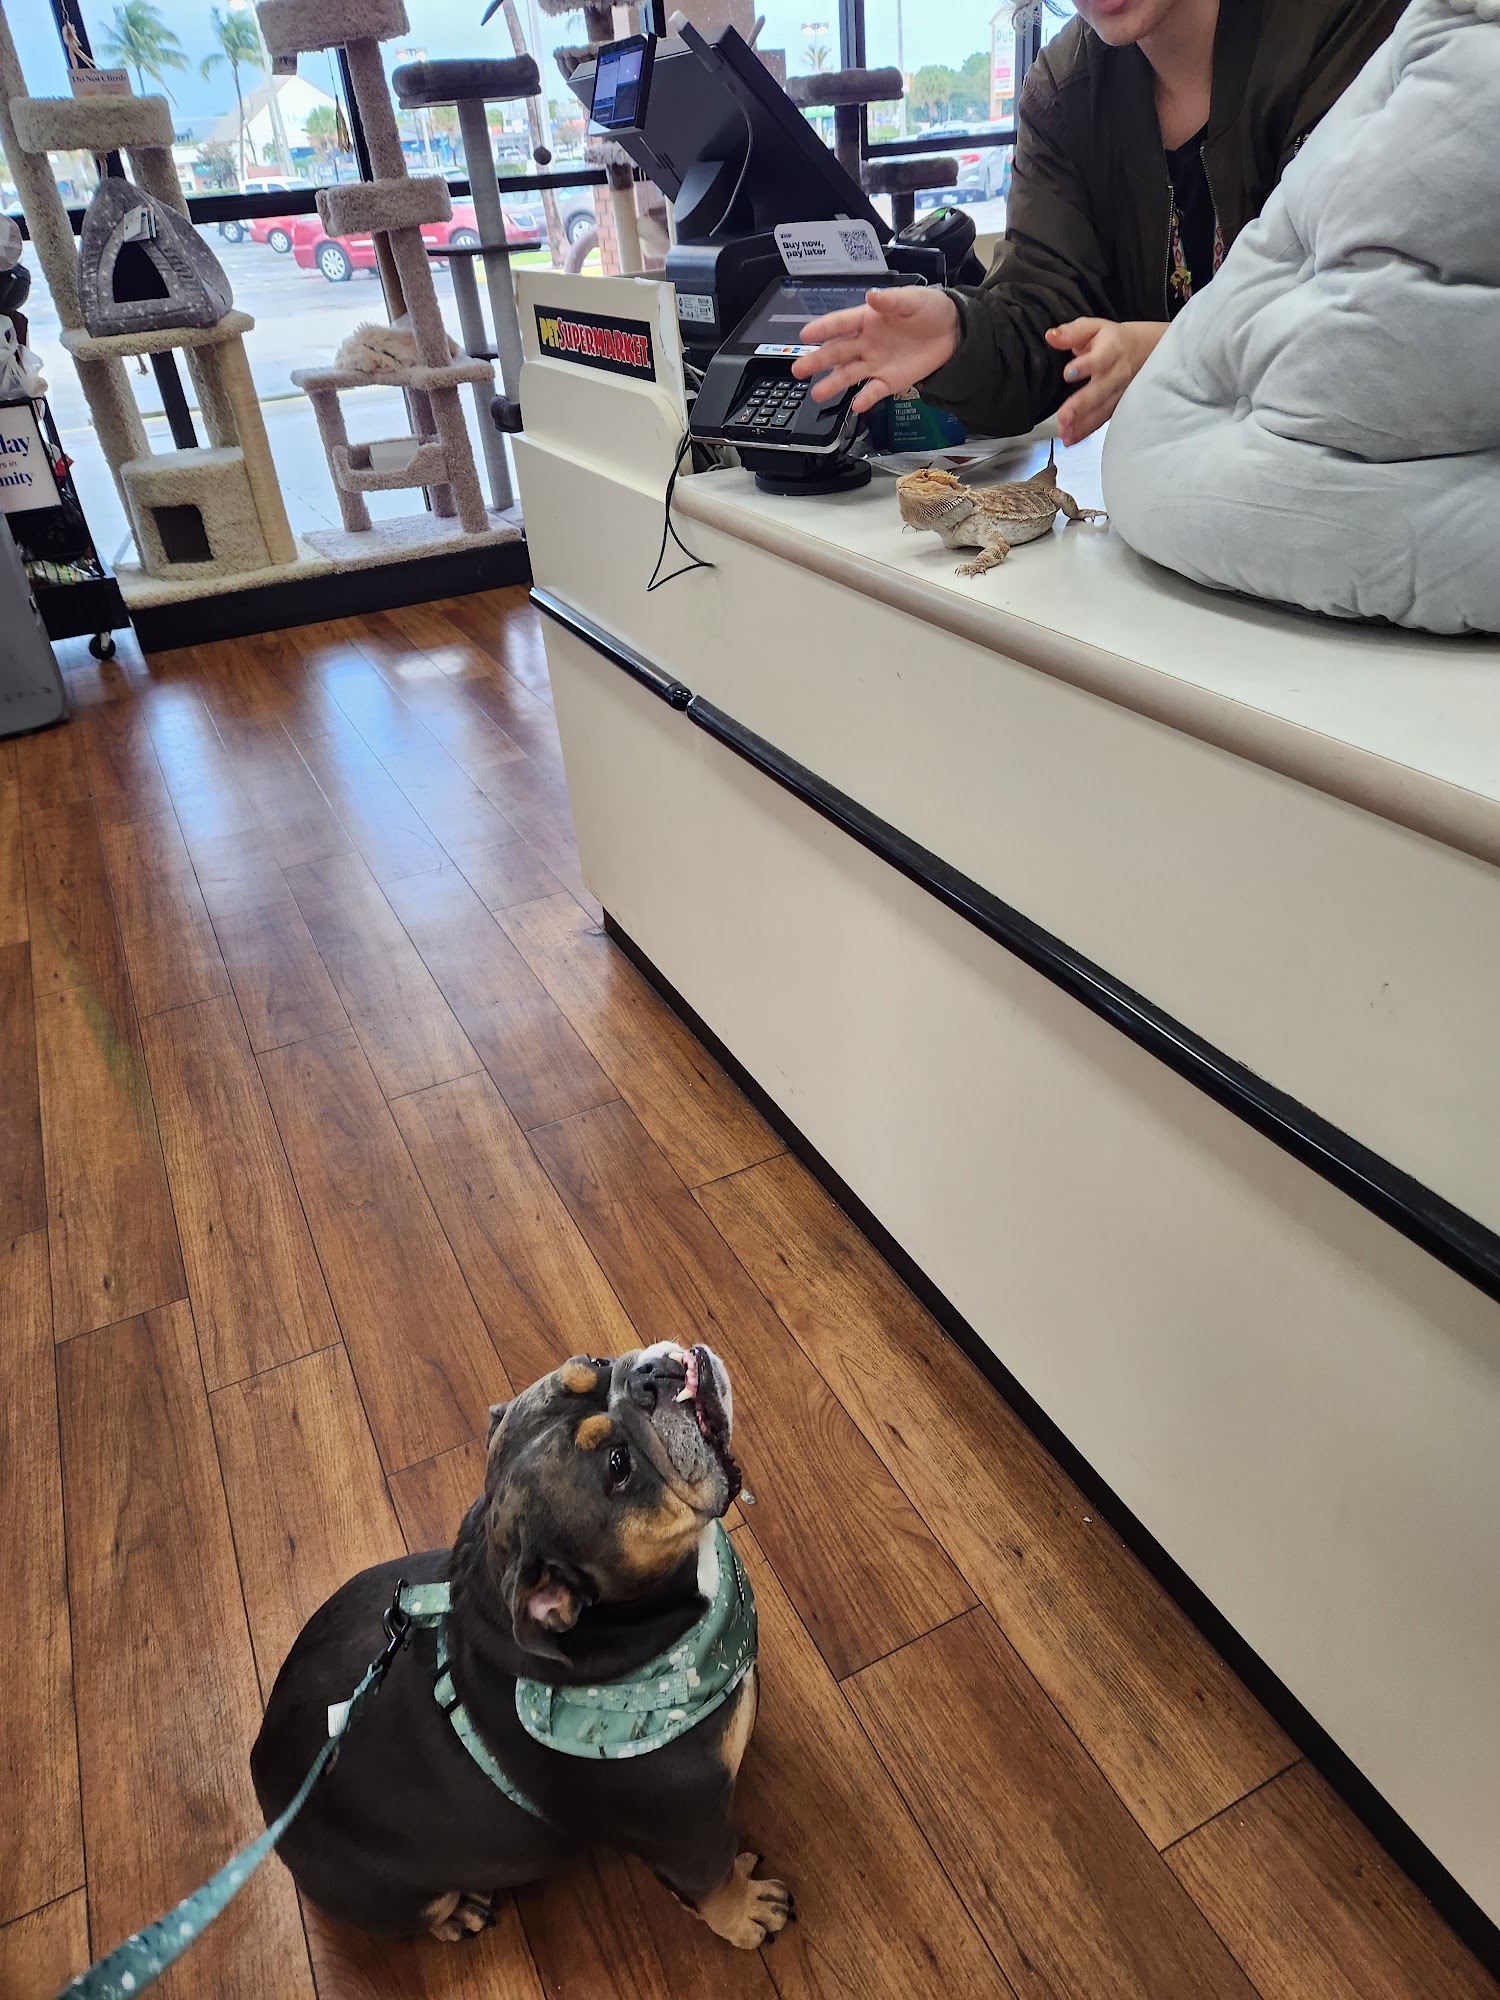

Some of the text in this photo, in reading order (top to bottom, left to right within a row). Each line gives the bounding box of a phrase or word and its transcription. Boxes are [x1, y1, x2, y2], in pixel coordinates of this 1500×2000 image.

[782, 240, 824, 250] Buy now,
[786, 248, 827, 259] pay later
